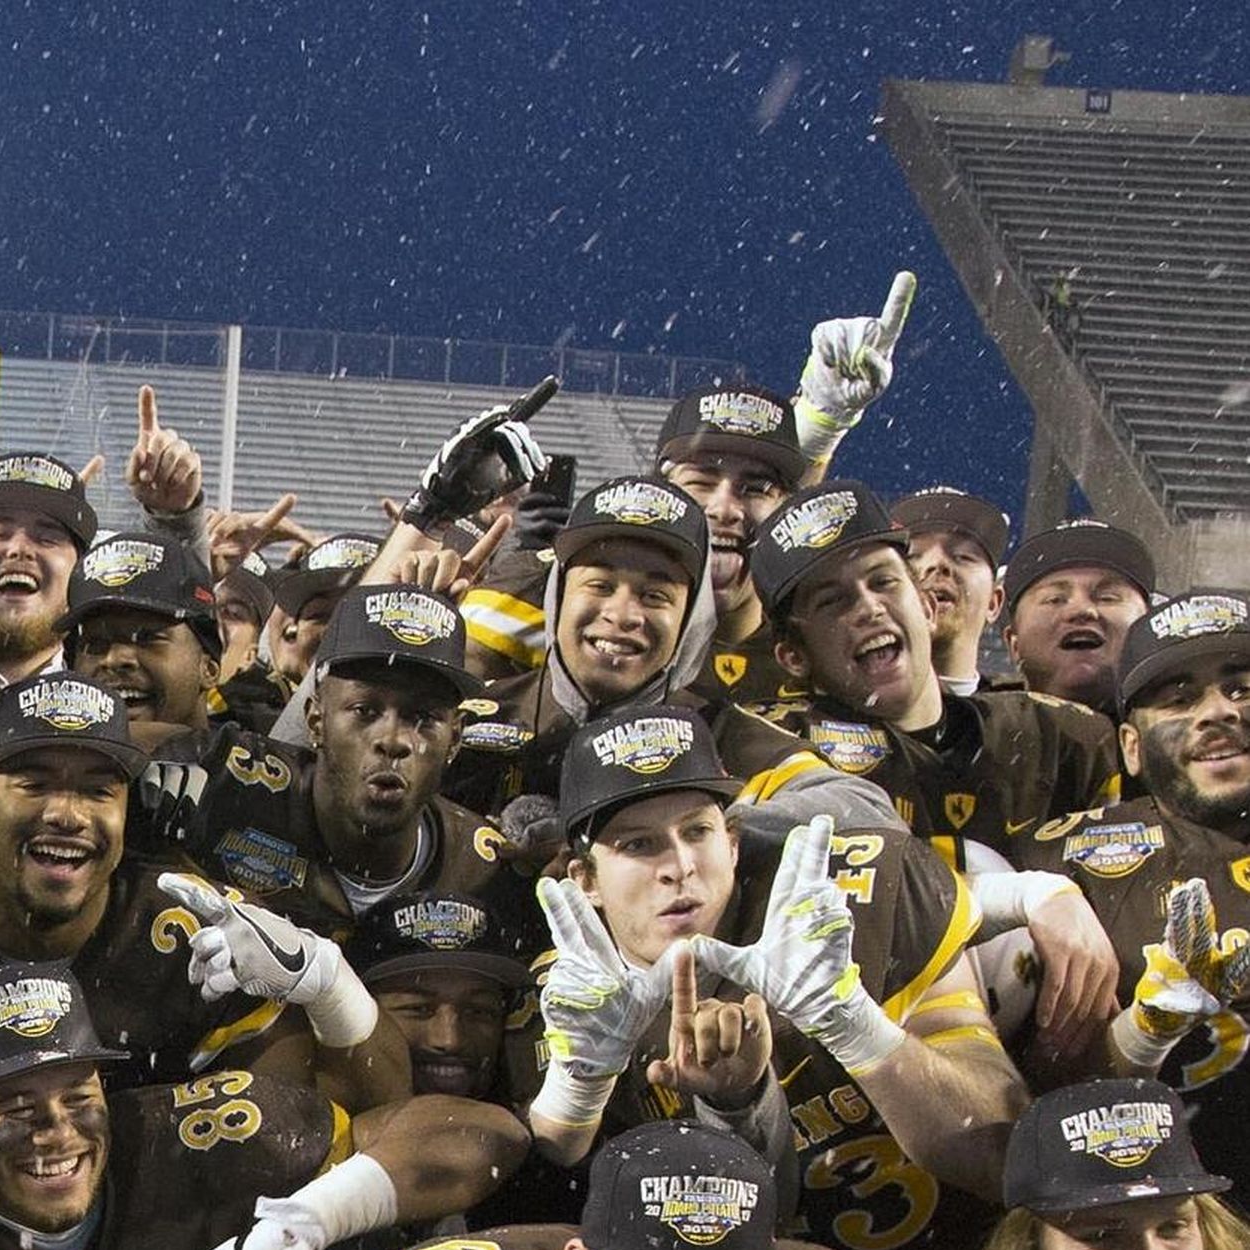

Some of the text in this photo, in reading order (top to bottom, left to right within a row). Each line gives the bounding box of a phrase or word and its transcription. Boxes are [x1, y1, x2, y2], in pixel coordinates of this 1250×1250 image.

[365, 592, 456, 631] CHAMPIONS
[18, 680, 114, 716] CHAMPIONS
[592, 718, 693, 757] CHAMPIONS
[394, 901, 488, 931] CHAMPIONS
[1060, 1102, 1173, 1141] CHAMPIONS
[639, 1175, 759, 1208] CHAMPIONS
[644, 1204, 661, 1217] 20
